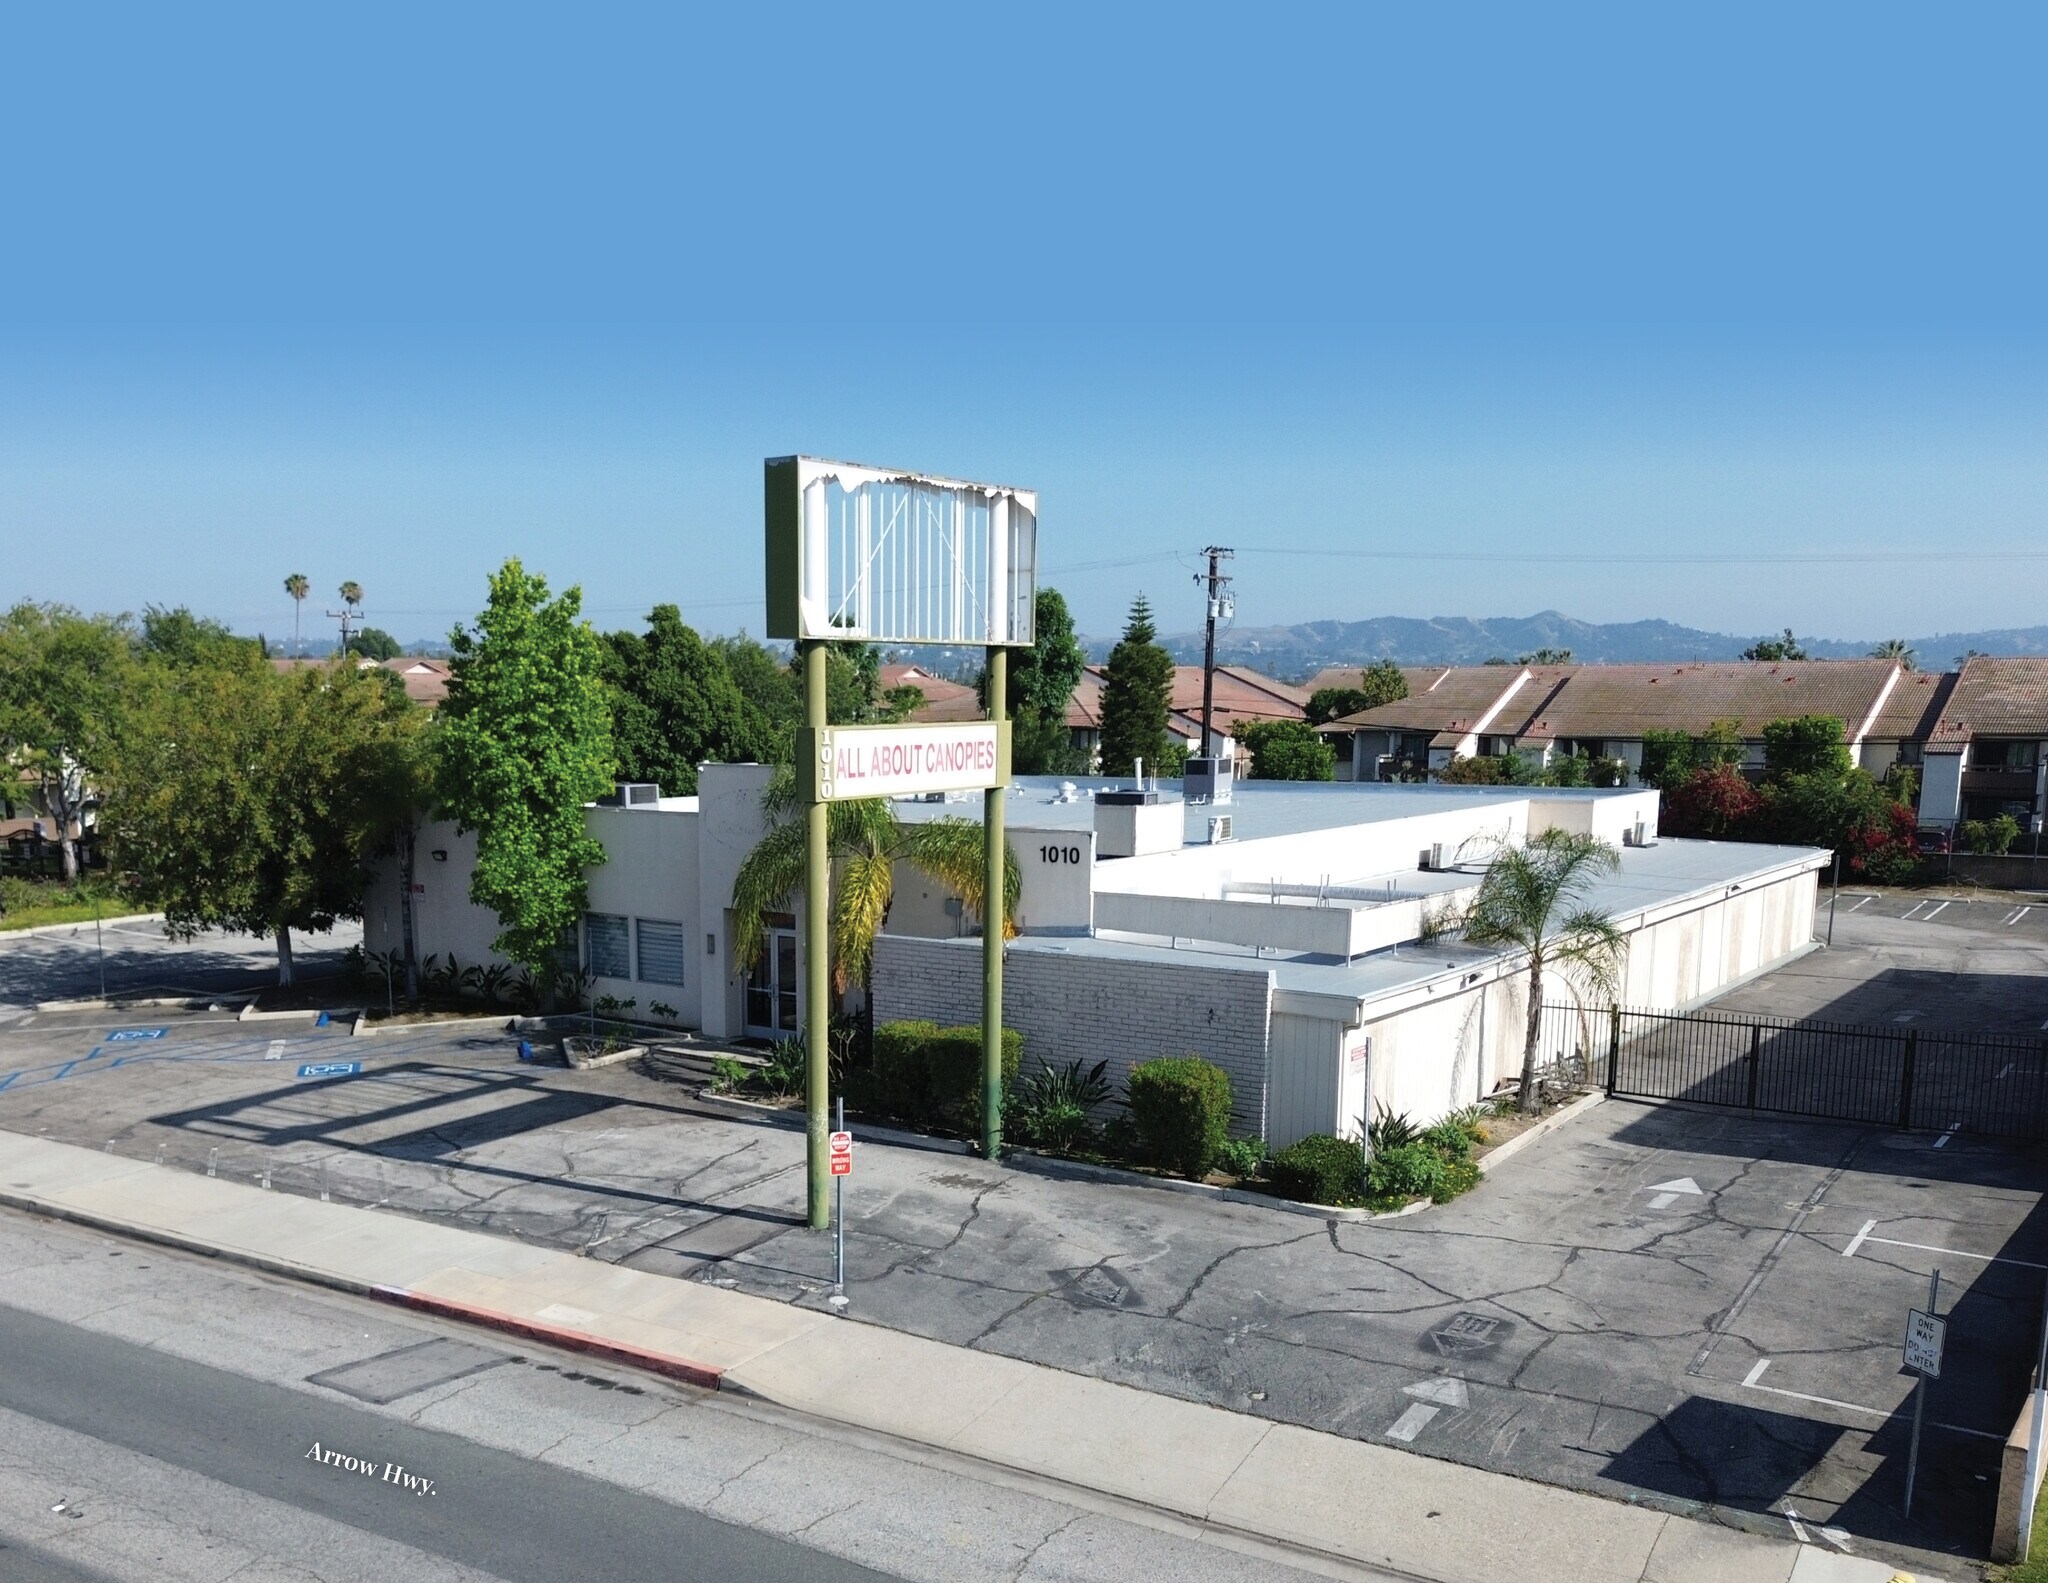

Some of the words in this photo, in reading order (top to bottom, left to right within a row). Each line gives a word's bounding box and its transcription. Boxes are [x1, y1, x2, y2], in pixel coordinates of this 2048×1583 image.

[821, 729, 833, 799] 1010
[836, 747, 866, 779] ALL
[870, 744, 922, 777] ABOUT
[925, 740, 994, 773] CANOPIES
[1040, 846, 1080, 865] 1010
[1918, 1318, 1935, 1331] ONE
[1916, 1328, 1934, 1342] WAY
